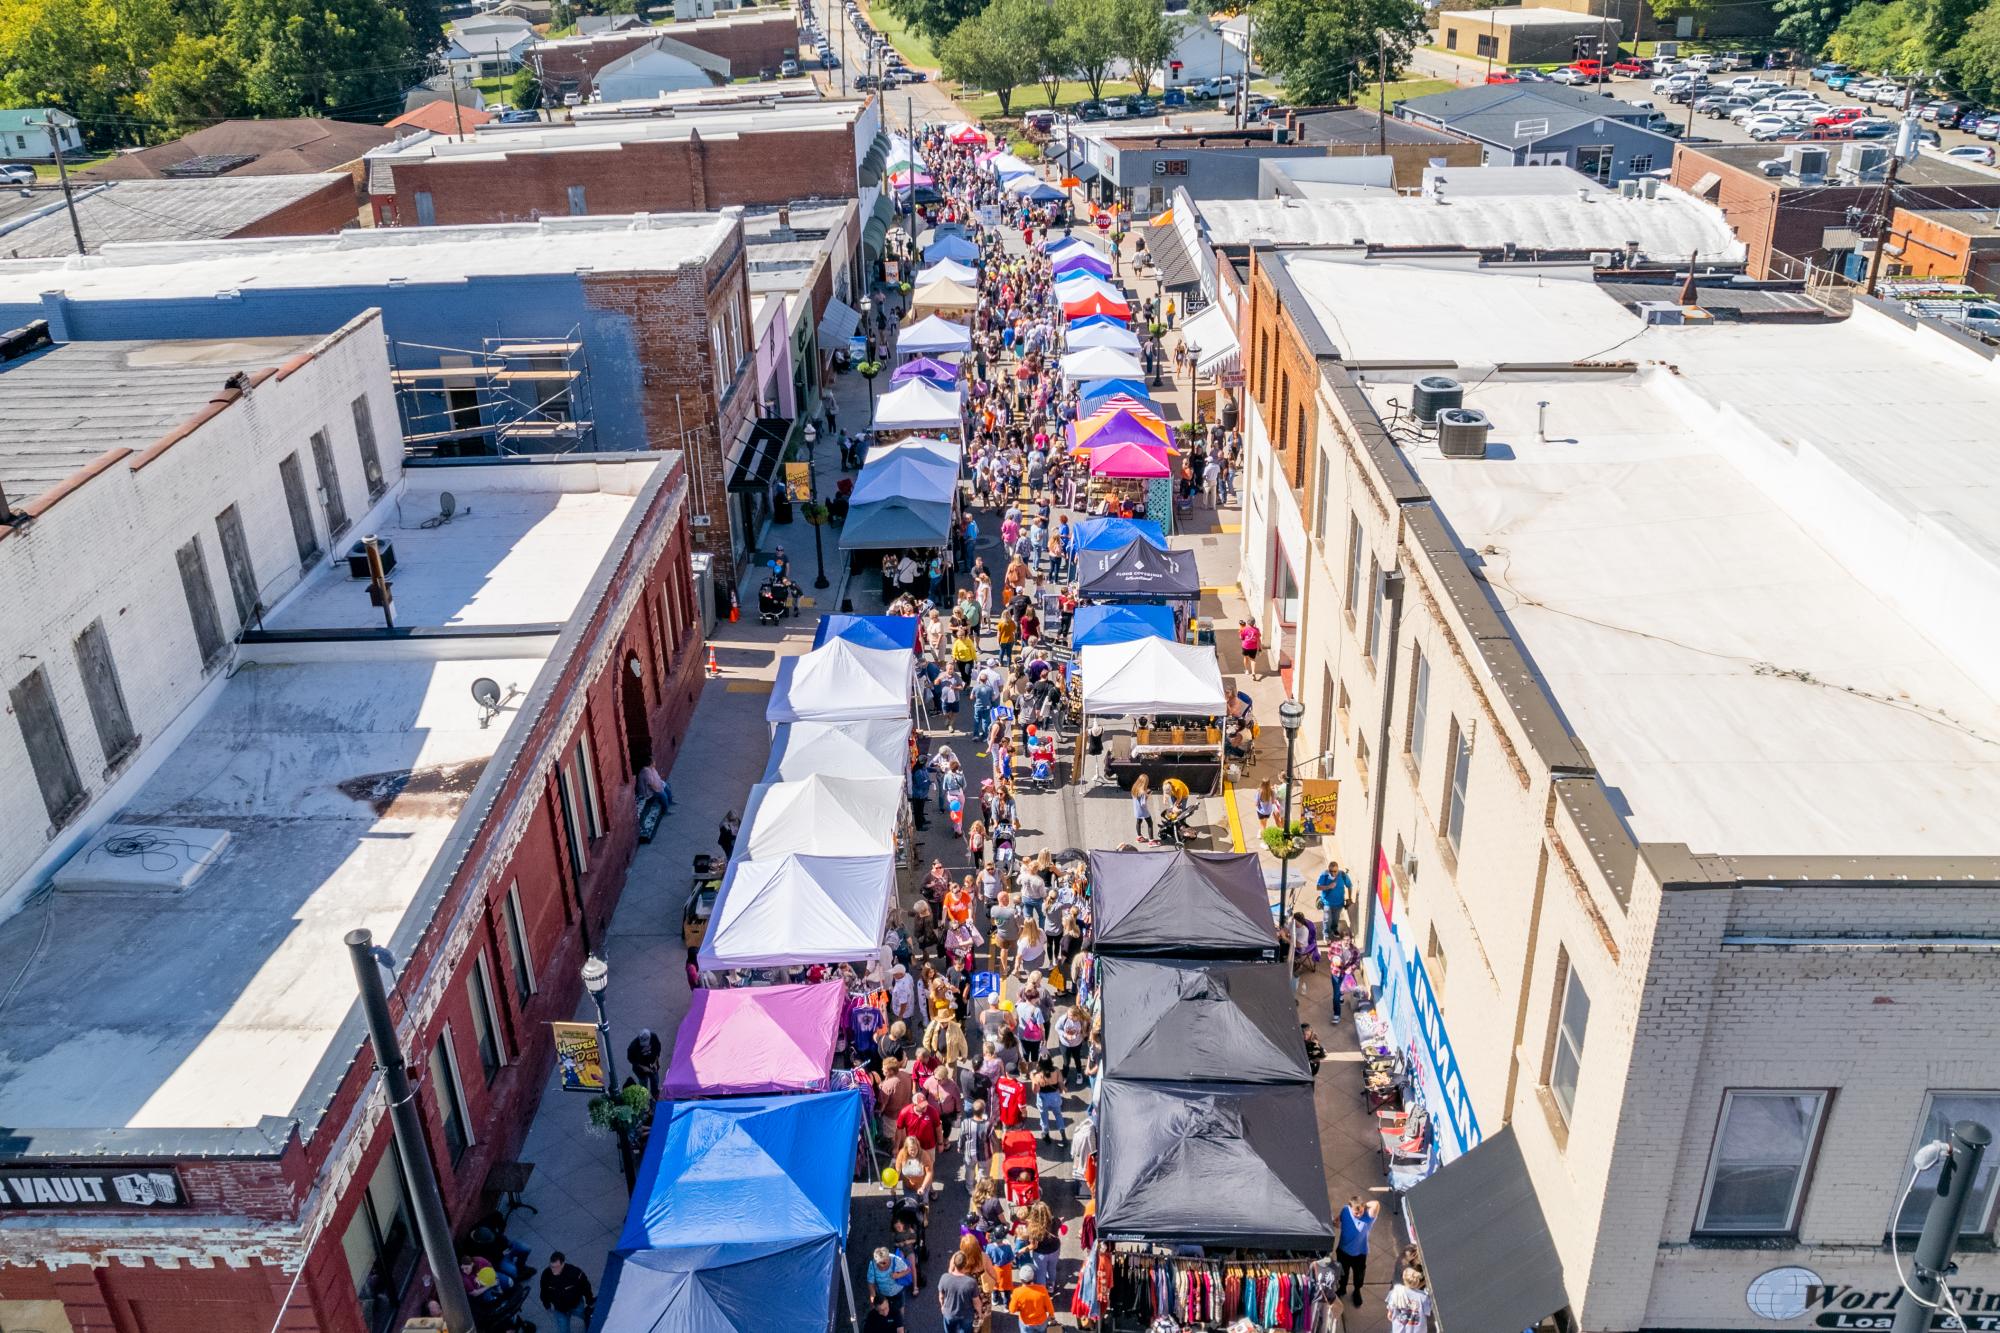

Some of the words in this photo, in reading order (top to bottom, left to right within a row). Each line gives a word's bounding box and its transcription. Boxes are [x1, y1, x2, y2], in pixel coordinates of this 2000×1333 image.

[1303, 792, 1337, 807] Harvest
[1316, 803, 1336, 816] Day
[557, 1040, 598, 1054] Harvest
[575, 1050, 599, 1065] Day
[1001, 1091, 1011, 1108] 7
[8, 1177, 107, 1203] VAULT
[1805, 1284, 1905, 1309] Worl
[1836, 1315, 1892, 1328] Loa
